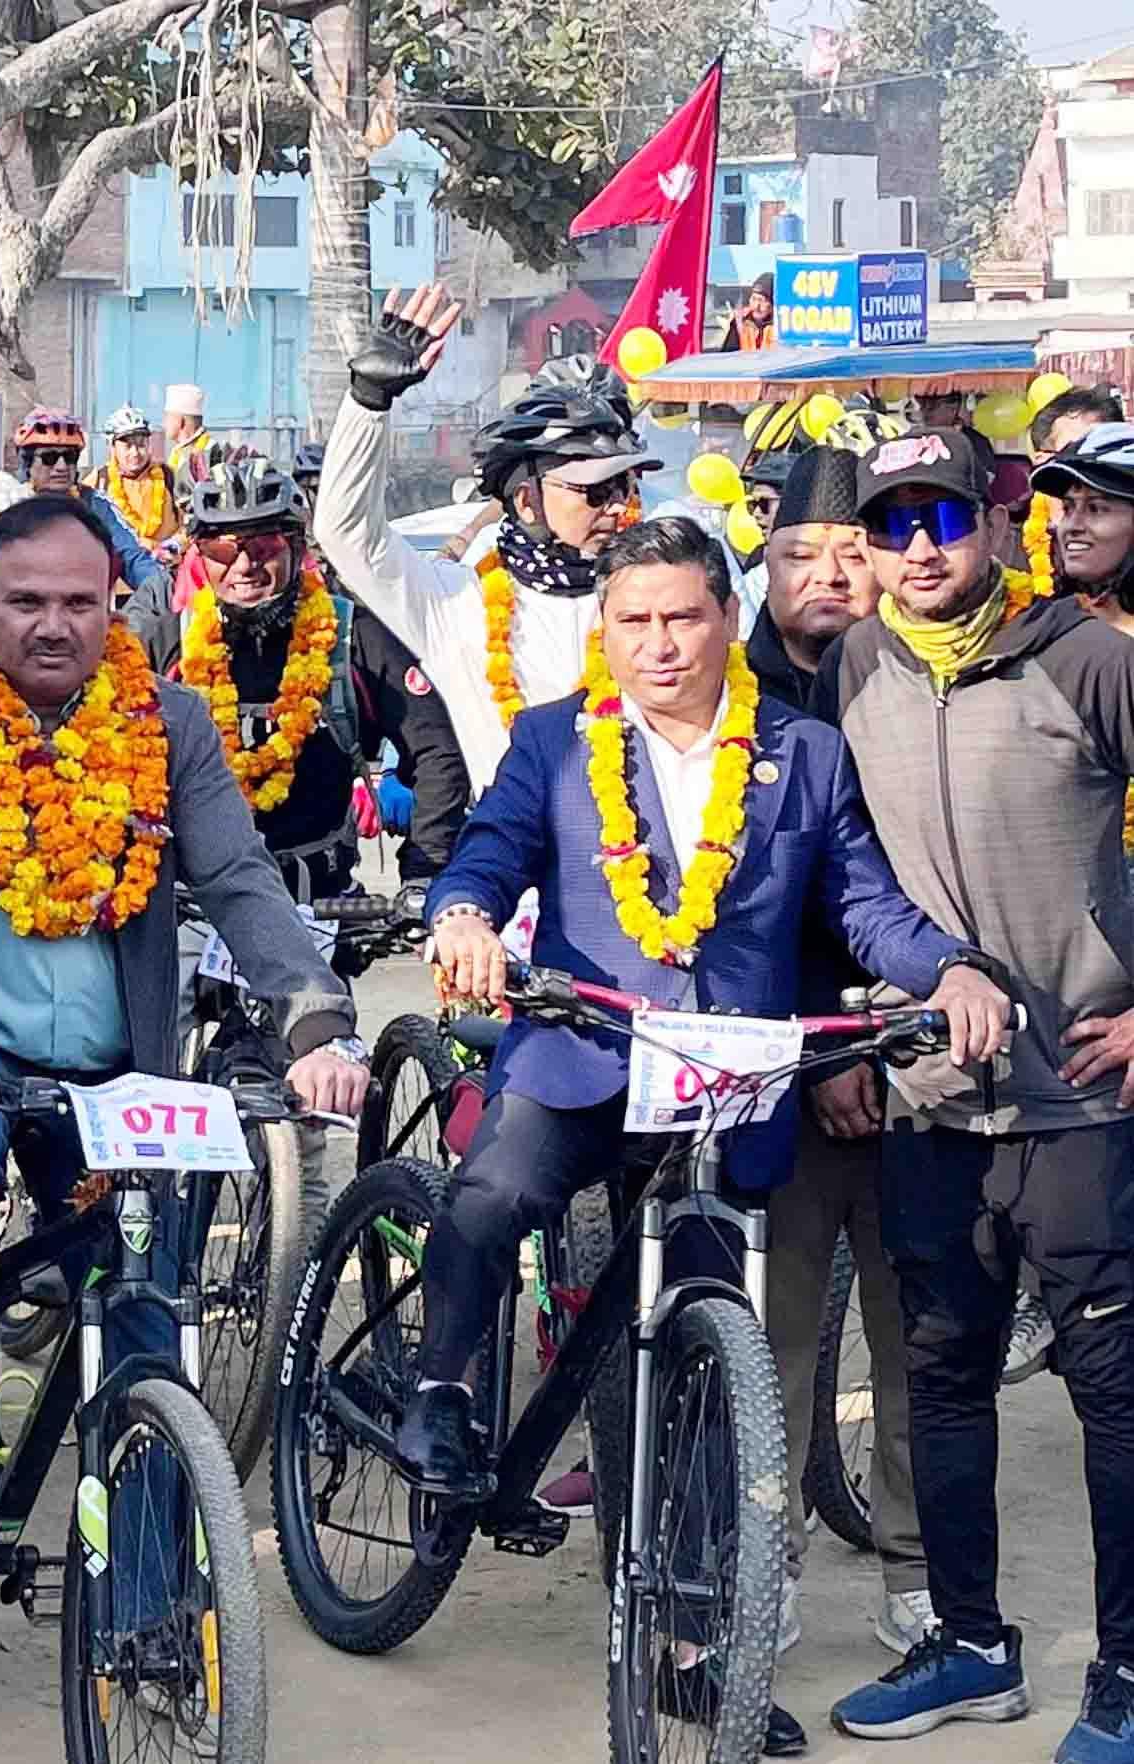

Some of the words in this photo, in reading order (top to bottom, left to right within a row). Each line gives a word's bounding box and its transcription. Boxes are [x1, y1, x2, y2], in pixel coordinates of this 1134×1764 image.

[792, 270, 839, 298] 48V
[861, 295, 922, 317] LITHIUM
[861, 319, 923, 342] BATTERY
[121, 1103, 209, 1137] 077
[289, 1259, 323, 1342] PATROL
